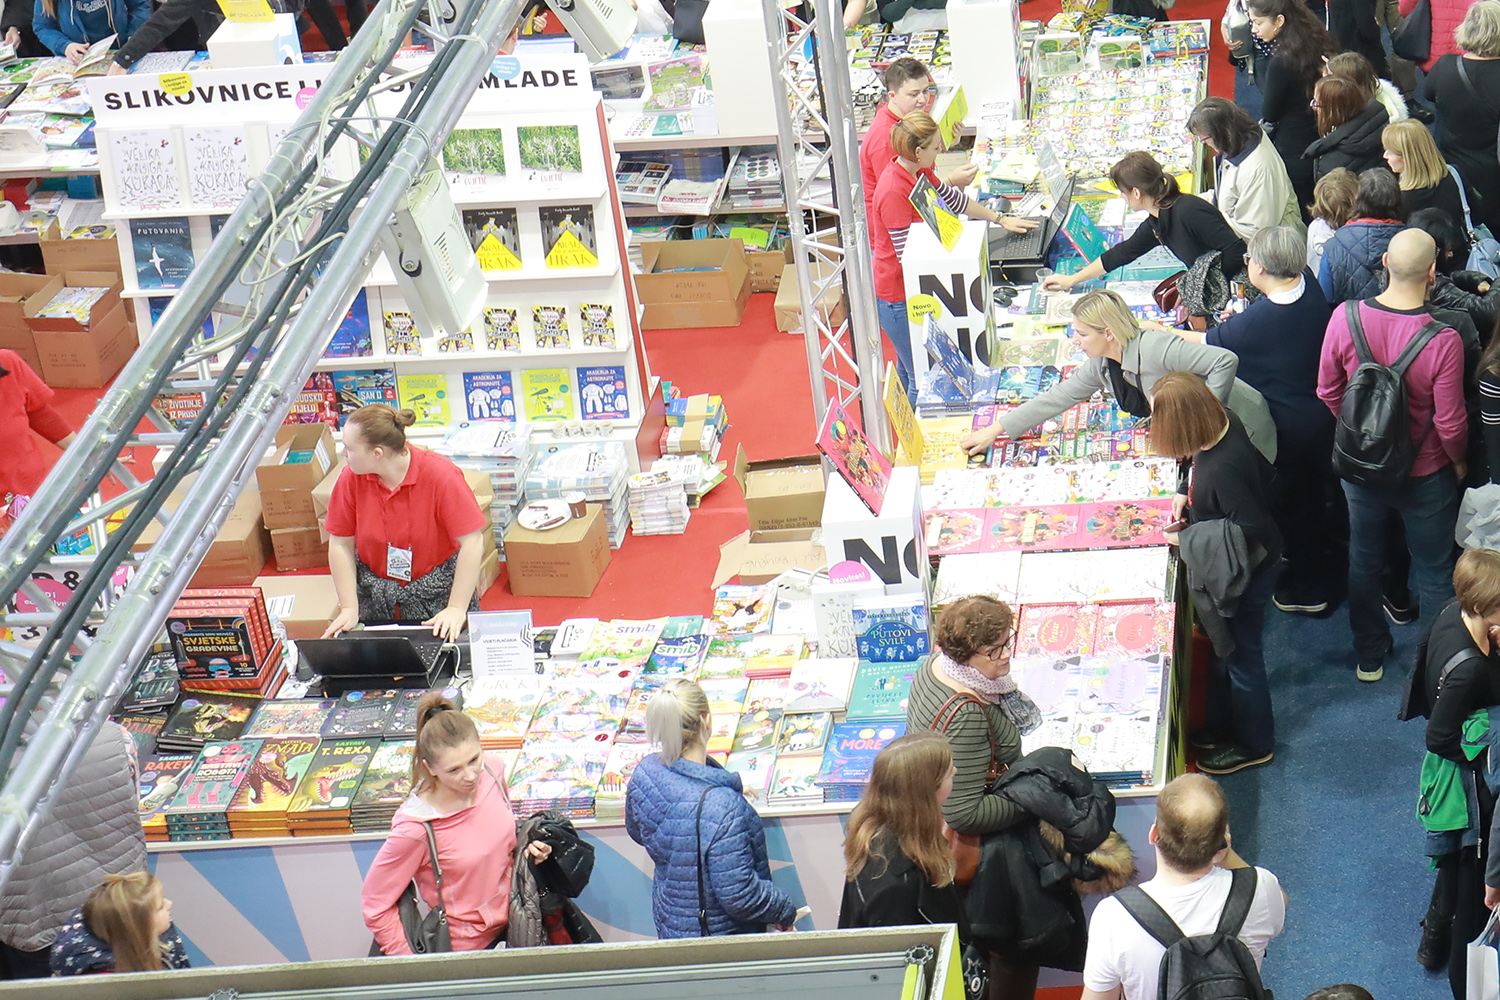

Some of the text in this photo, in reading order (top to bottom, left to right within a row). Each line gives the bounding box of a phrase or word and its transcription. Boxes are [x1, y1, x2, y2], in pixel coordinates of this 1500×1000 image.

[478, 69, 579, 90] MLADE
[104, 80, 292, 111] SLIKOVNICE
[126, 147, 160, 161] VELIKA
[199, 145, 234, 159] VELIKA
[127, 161, 163, 175] KNJIGA
[200, 159, 236, 173] KNJIGA
[123, 174, 174, 192] KUKACA
[196, 173, 247, 191] KUKACA
[137, 227, 185, 235] PUTOVANJA
[361, 390, 375, 401] SAN
[169, 398, 203, 410] ŽIVOTINJE
[293, 402, 317, 413] TIJELO
[616, 623, 656, 634] smib
[871, 628, 912, 639] PUTOVI
[183, 636, 237, 646] SVJETSKE
[878, 636, 906, 647] SVILE
[656, 642, 699, 655] smib
[866, 691, 902, 699] POVIJEST
[264, 742, 316, 755] ZMAJA
[840, 737, 884, 751] MORE
[321, 745, 371, 756] T. REXA
[197, 768, 238, 776] ROBOTA
[200, 762, 241, 770] SASTAVI
